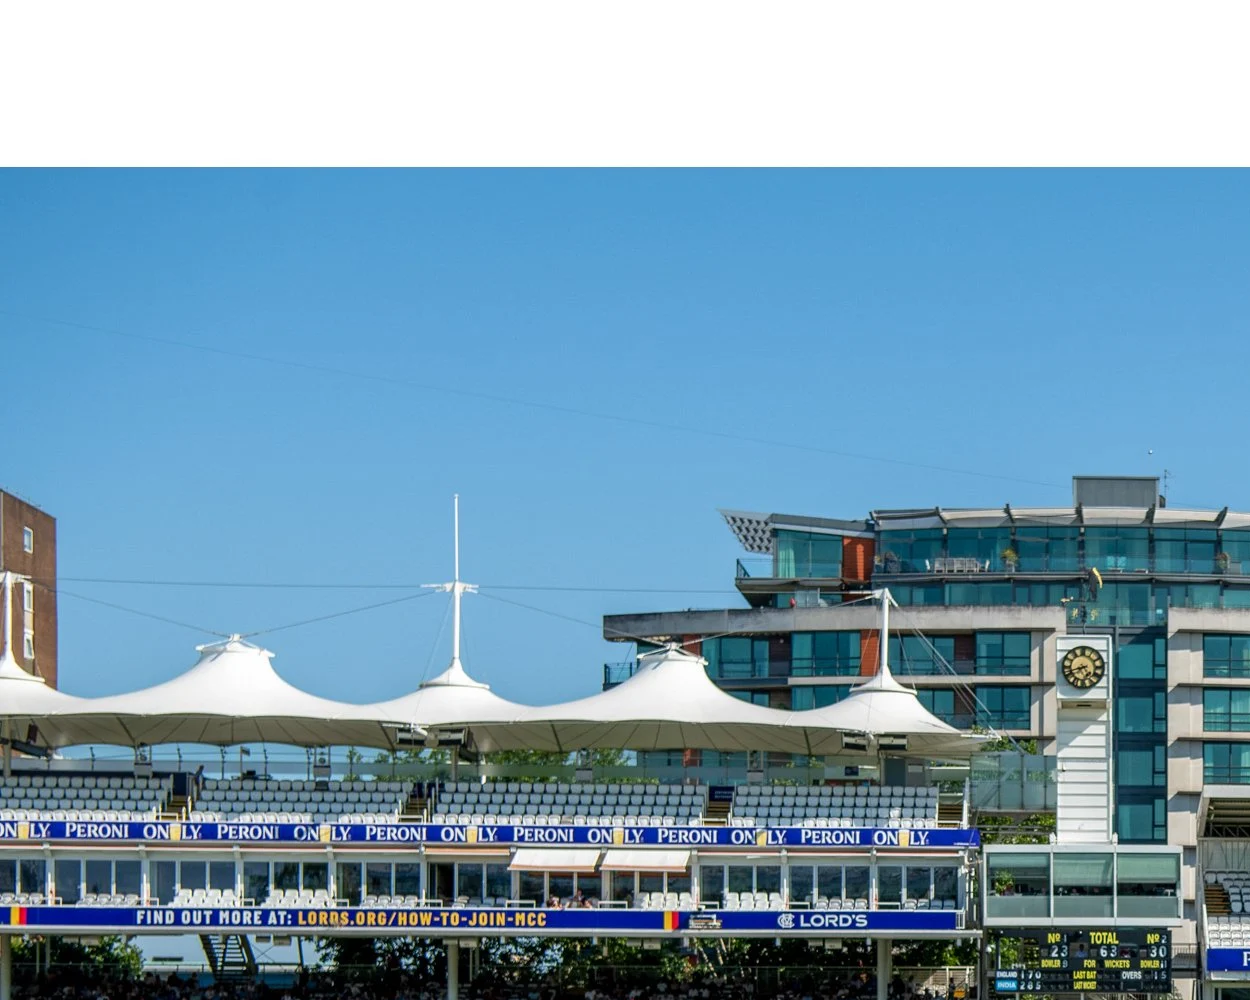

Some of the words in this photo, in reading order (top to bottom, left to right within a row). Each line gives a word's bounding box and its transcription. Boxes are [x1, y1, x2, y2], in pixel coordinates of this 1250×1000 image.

[65, 824, 128, 838] PERONI
[217, 824, 279, 840] PERONI
[366, 826, 427, 840] PERONI
[513, 827, 574, 842] PERONI
[658, 828, 717, 843] PERONI
[801, 830, 860, 844] PERONI
[136, 910, 174, 924] FIND
[182, 910, 213, 924] OUT
[219, 911, 262, 925] MORE
[268, 912, 292, 925] AT:
[298, 912, 547, 926] LORDS.ORG/HOW-TO-JOIN-MCC
[800, 914, 868, 927] LORD'S
[1090, 932, 1119, 944] TOTAL
[1041, 959, 1061, 968] BOWLER
[1084, 960, 1096, 968] FOR
[1104, 960, 1130, 968] WICKETS
[1140, 960, 1160, 968] BOWLER
[1073, 971, 1086, 979] LAST
[1087, 971, 1096, 979] BAT
[1122, 971, 1142, 979] OVERS
